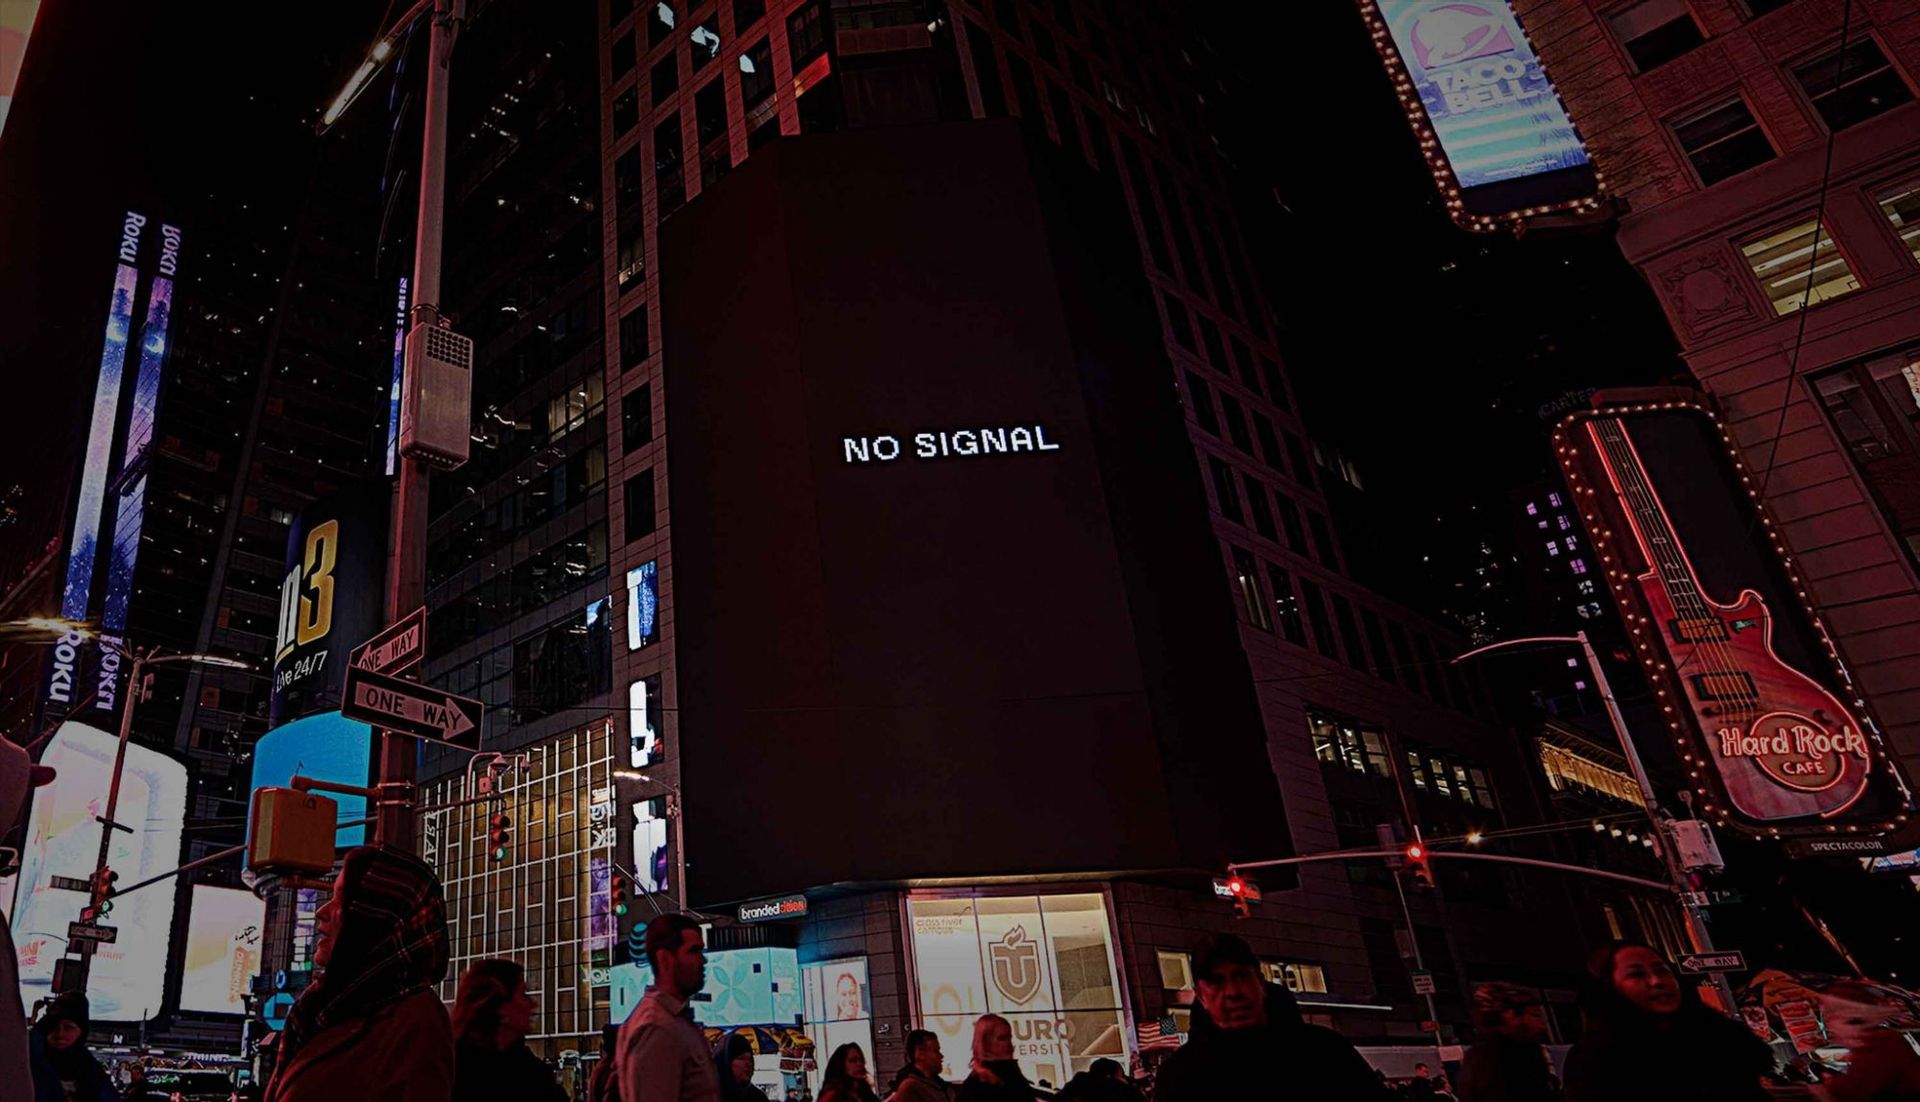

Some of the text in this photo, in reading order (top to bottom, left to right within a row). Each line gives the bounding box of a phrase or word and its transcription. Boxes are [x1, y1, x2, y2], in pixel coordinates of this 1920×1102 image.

[1426, 57, 1527, 96] TACO
[1446, 79, 1541, 115] BELL
[842, 425, 1060, 463] NO SIGNAL
[294, 650, 328, 681] 24/7
[361, 629, 415, 671] ONE WAY
[366, 688, 462, 730] ONE WAY
[1718, 725, 1869, 760] Hard Rock
[1782, 761, 1826, 775] CAFE
[1810, 840, 1884, 852] SPECTACOLOR
[1011, 1018, 1076, 1041] URO
